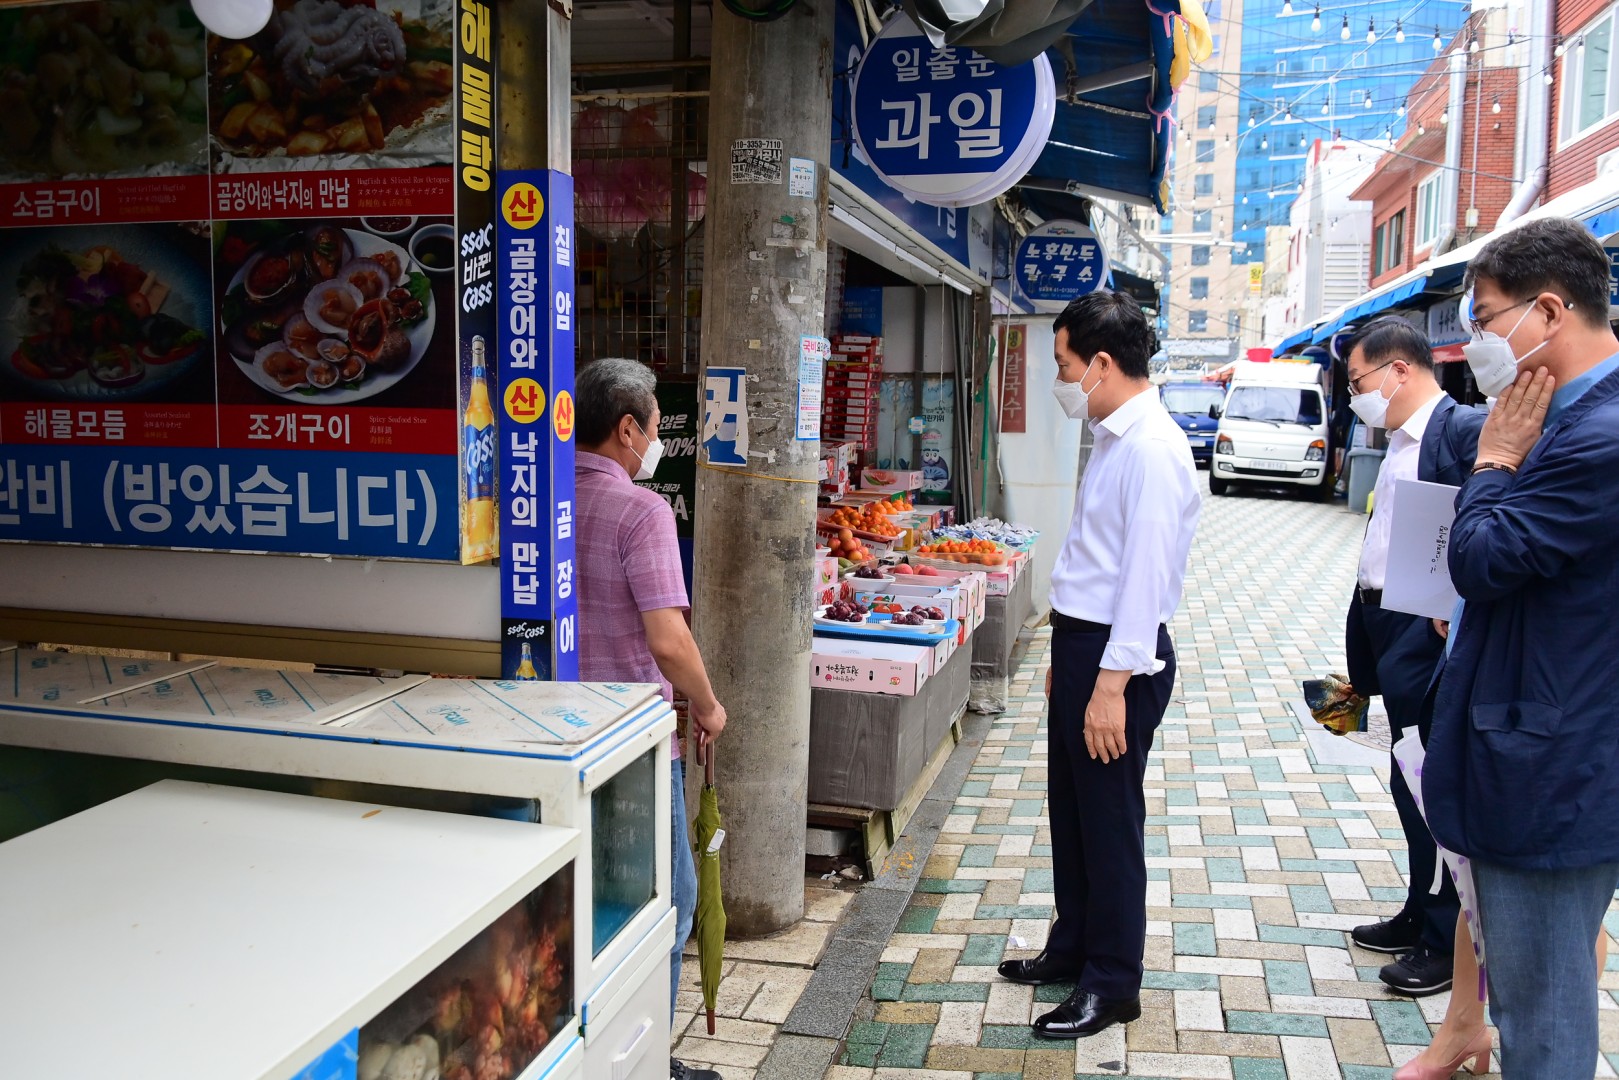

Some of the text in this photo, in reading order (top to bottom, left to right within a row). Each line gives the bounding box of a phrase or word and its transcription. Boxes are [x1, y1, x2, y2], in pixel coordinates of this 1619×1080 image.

[875, 88, 1005, 160] 과일
[12, 187, 101, 218] 소금구이
[319, 177, 351, 208] 만남
[463, 251, 492, 286] 바뀐
[1024, 264, 1093, 283] 칼국수
[508, 190, 540, 606] 산 곰장어와 산 낙지의 만남
[24, 408, 127, 440] 해물모듬
[248, 413, 351, 444] 조개구이
[659, 414, 688, 430] 않은
[103, 458, 438, 546] (방있습니다)
[555, 397, 574, 655] 산 곰장어
